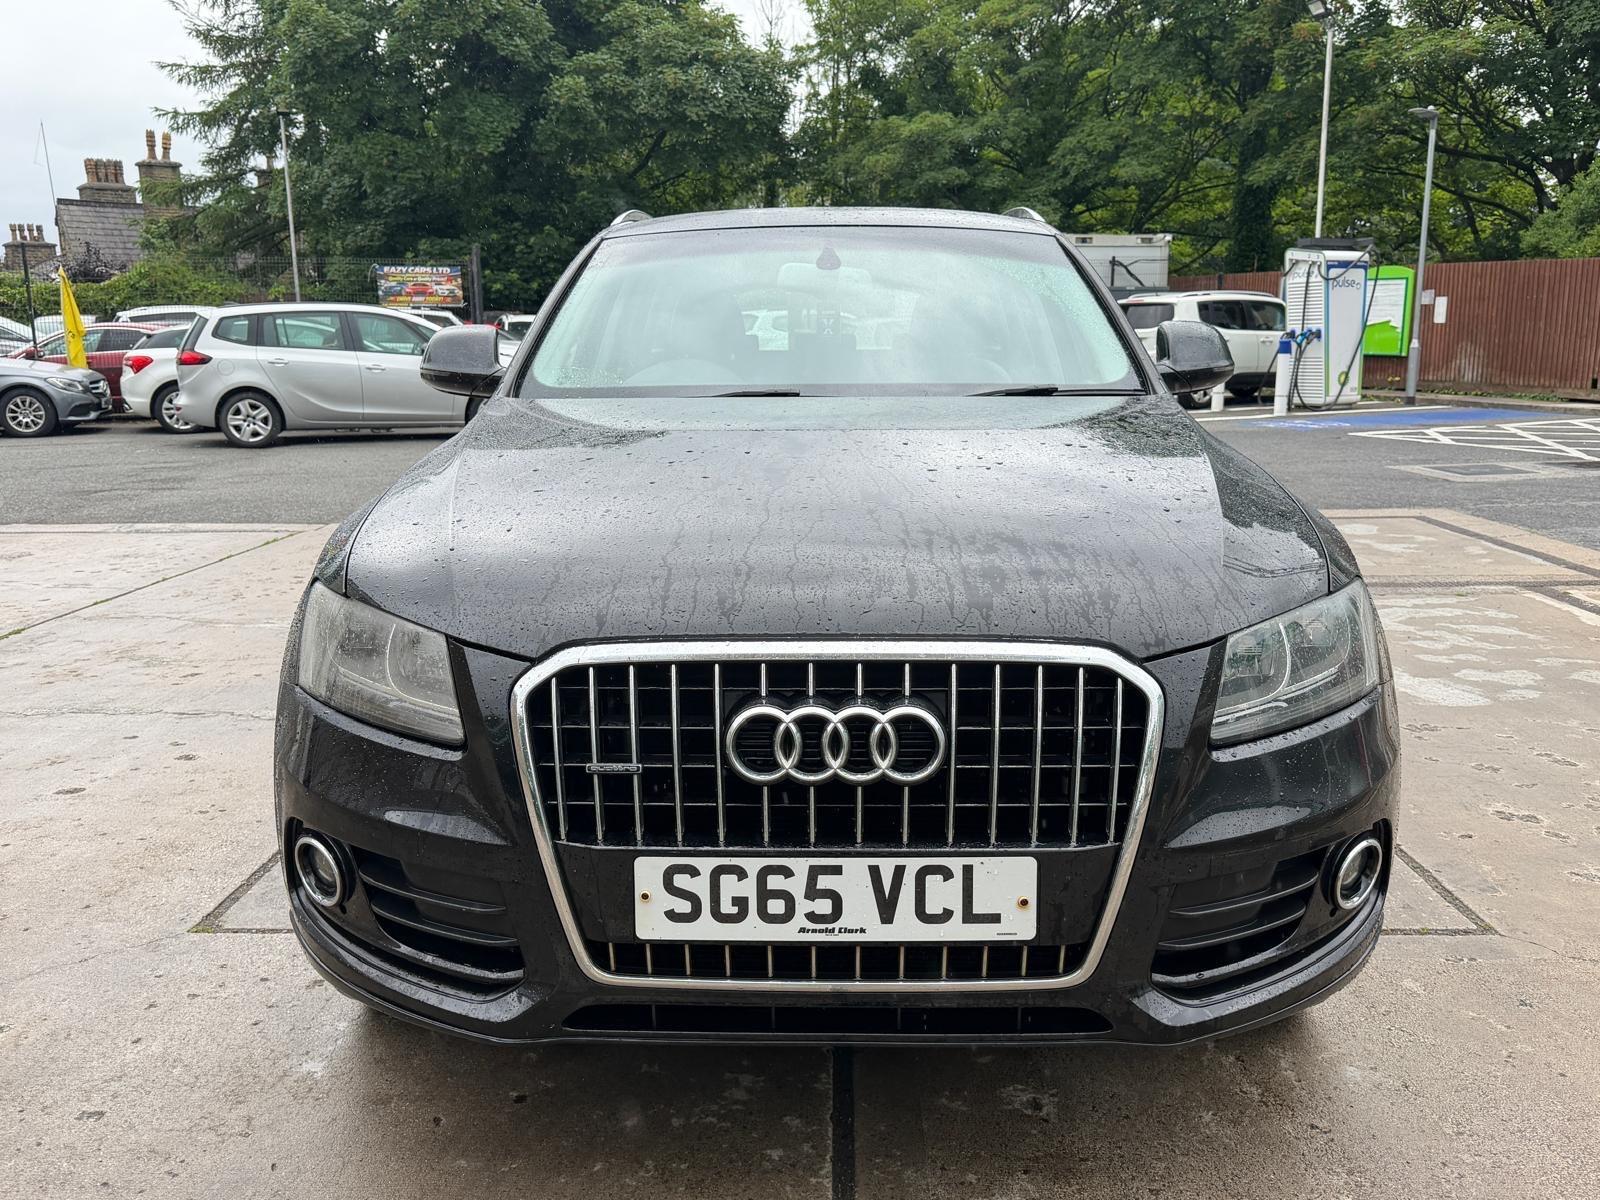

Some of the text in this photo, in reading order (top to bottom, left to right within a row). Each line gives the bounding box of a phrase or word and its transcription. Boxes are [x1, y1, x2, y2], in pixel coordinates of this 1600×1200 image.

[383, 266, 451, 274] EAZY CARS LTD
[1292, 267, 1314, 280] pule
[1332, 276, 1356, 290] pulse
[662, 863, 1002, 925] SG65 VCL
[797, 926, 867, 934] Arnold Clark
